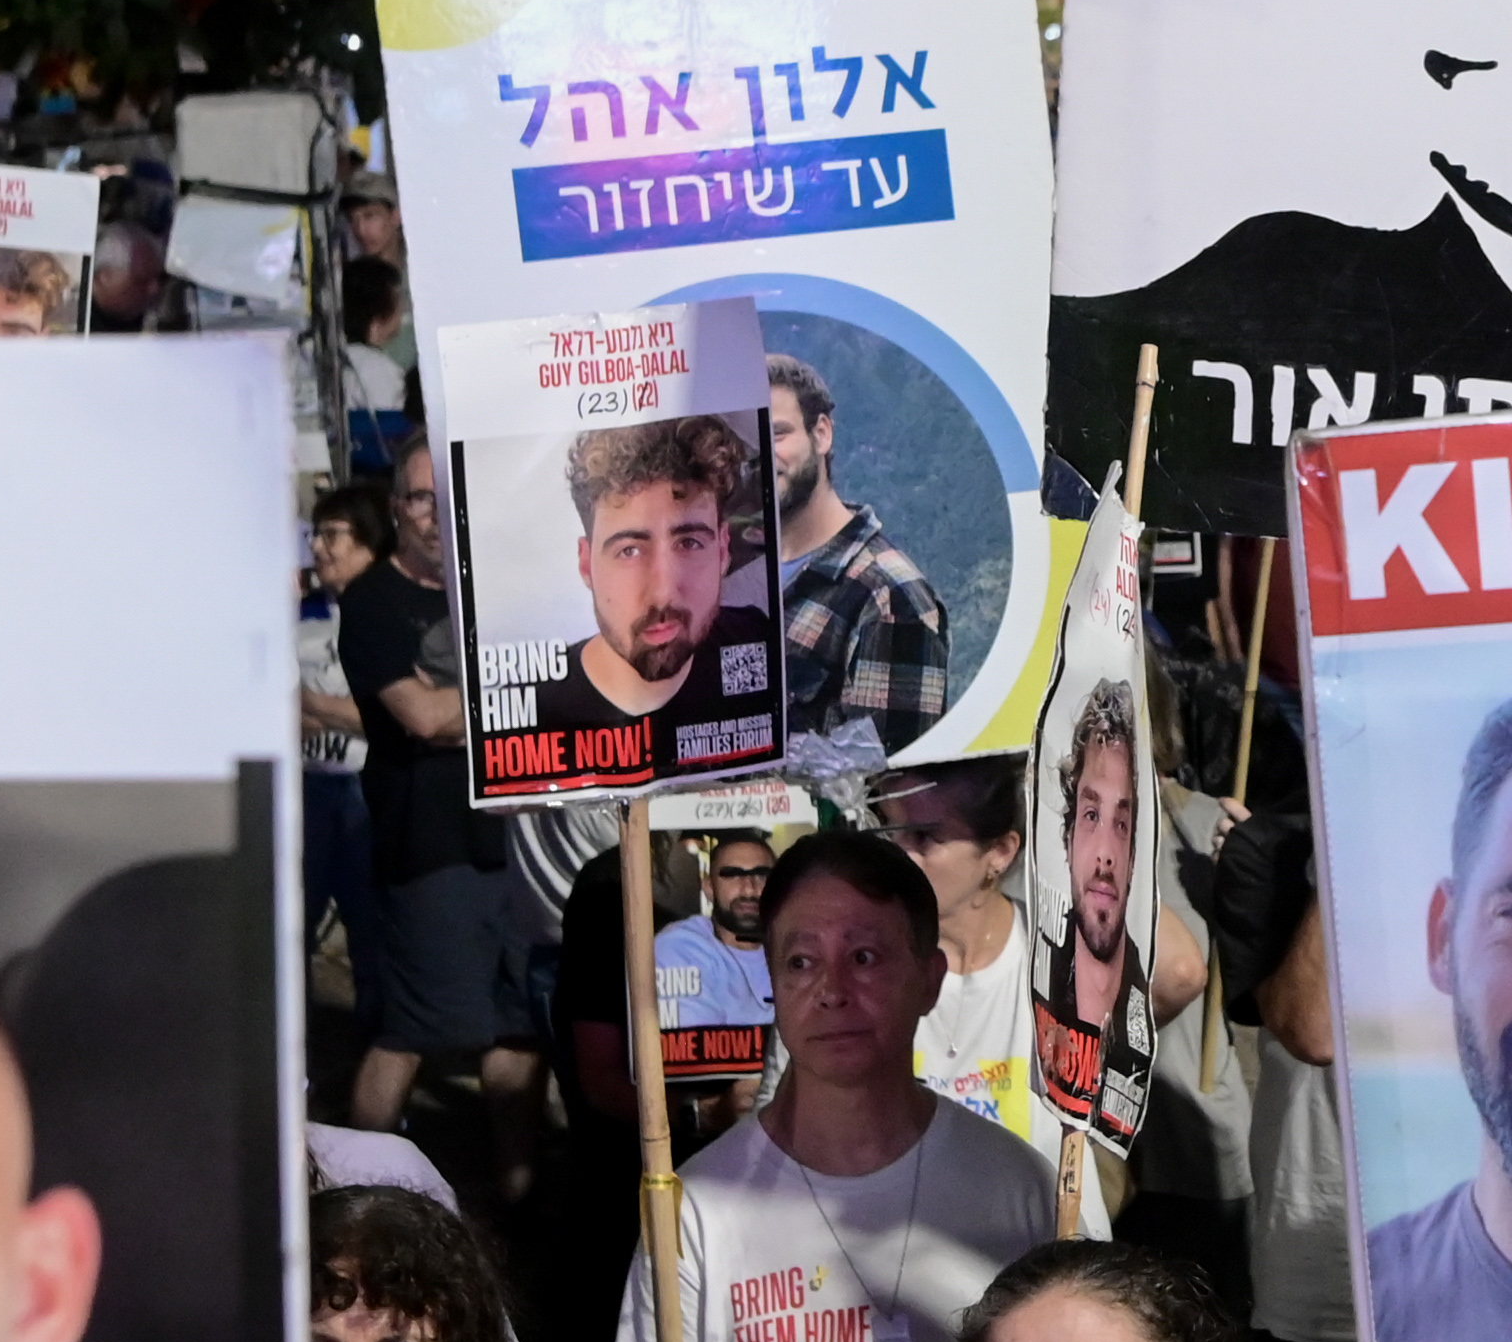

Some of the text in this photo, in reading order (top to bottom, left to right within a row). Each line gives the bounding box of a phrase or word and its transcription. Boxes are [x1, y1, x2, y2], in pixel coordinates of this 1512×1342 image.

[498, 45, 938, 149] אלון אהל
[558, 151, 913, 235] עד שיחזור
[648, 322, 675, 347] גיא
[539, 349, 690, 389] GUY GILBOA-DALAL
[577, 389, 628, 419] (23)
[478, 638, 569, 687] BRING
[480, 685, 538, 733] HIM
[484, 715, 653, 779] HOME NOW!
[676, 720, 719, 740] HOSTAGES
[721, 719, 736, 734] AND
[677, 727, 772, 759] FAMILIES FORUM
[655, 965, 702, 998] RING
[704, 1026, 764, 1061] NOW!
[730, 1266, 805, 1324] BRING
